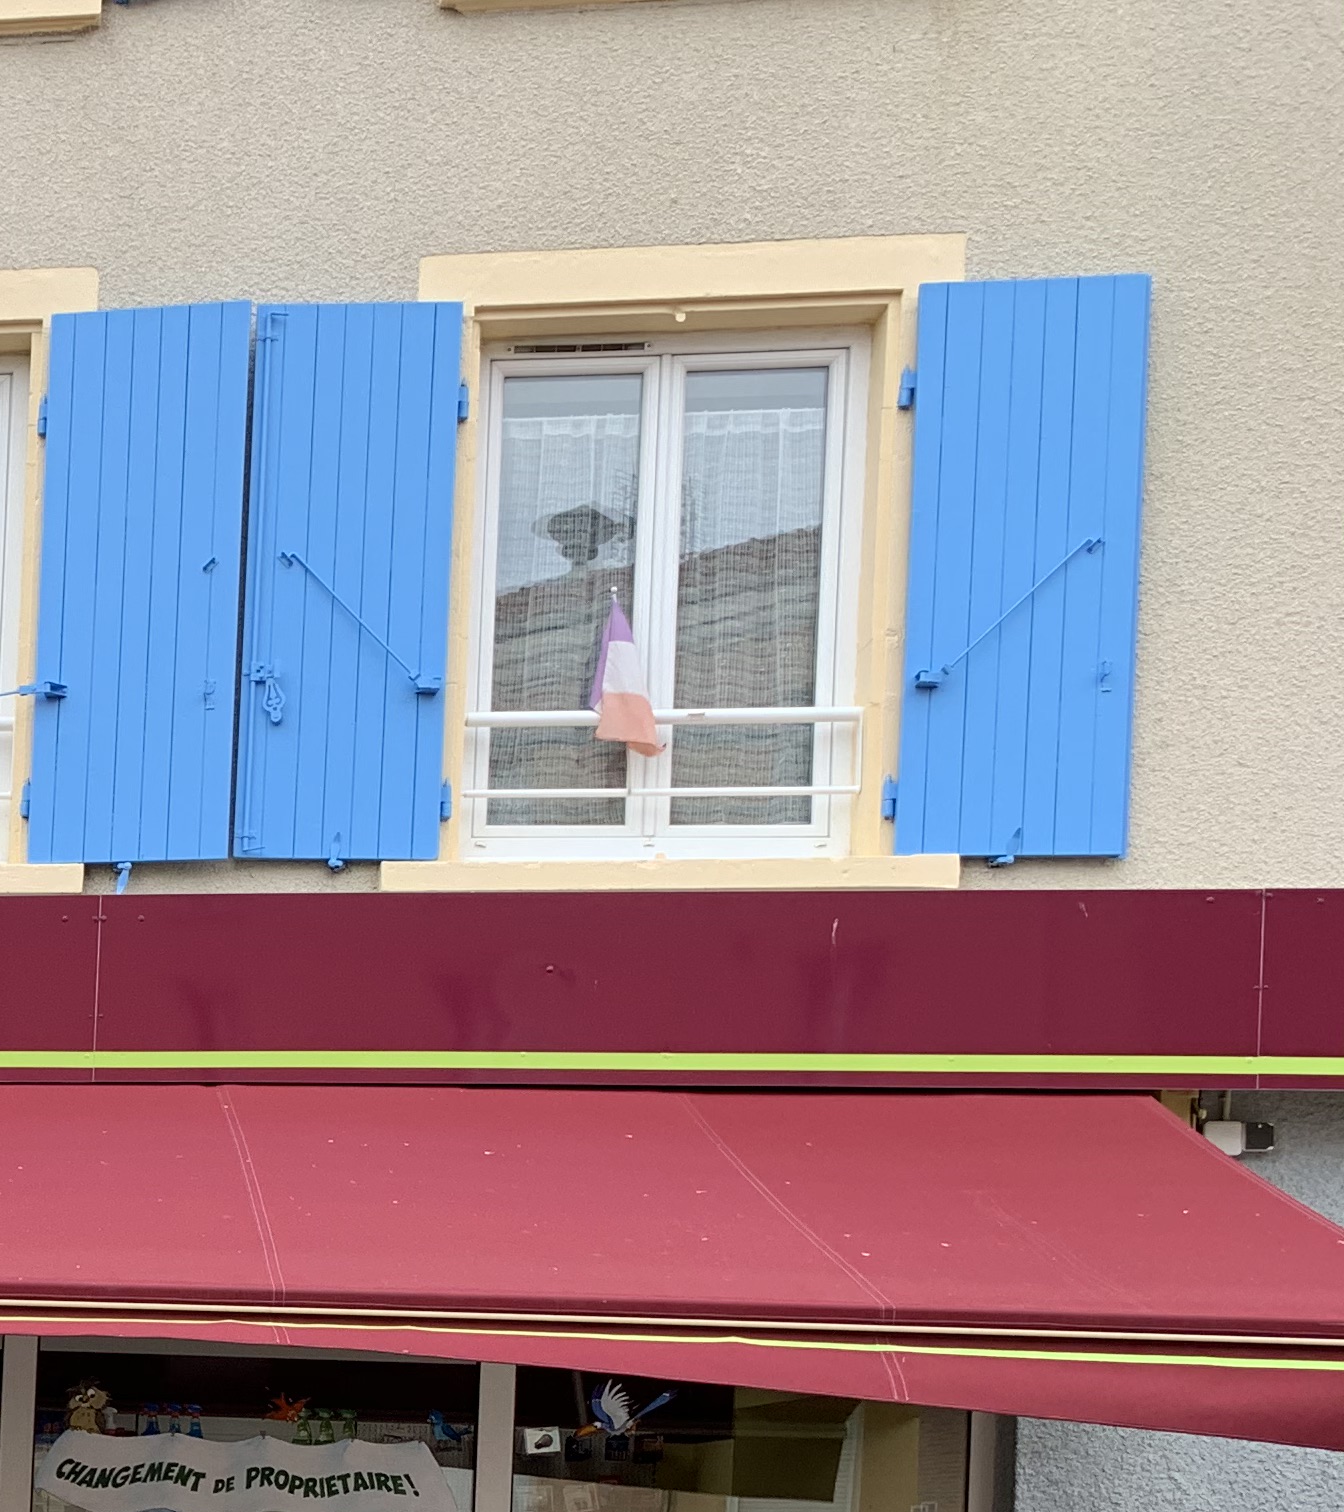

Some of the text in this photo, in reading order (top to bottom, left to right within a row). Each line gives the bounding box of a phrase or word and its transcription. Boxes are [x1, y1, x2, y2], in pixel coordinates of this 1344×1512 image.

[56, 1457, 419, 1499] CHANGEMENT DE PROPRIETAIRE!
